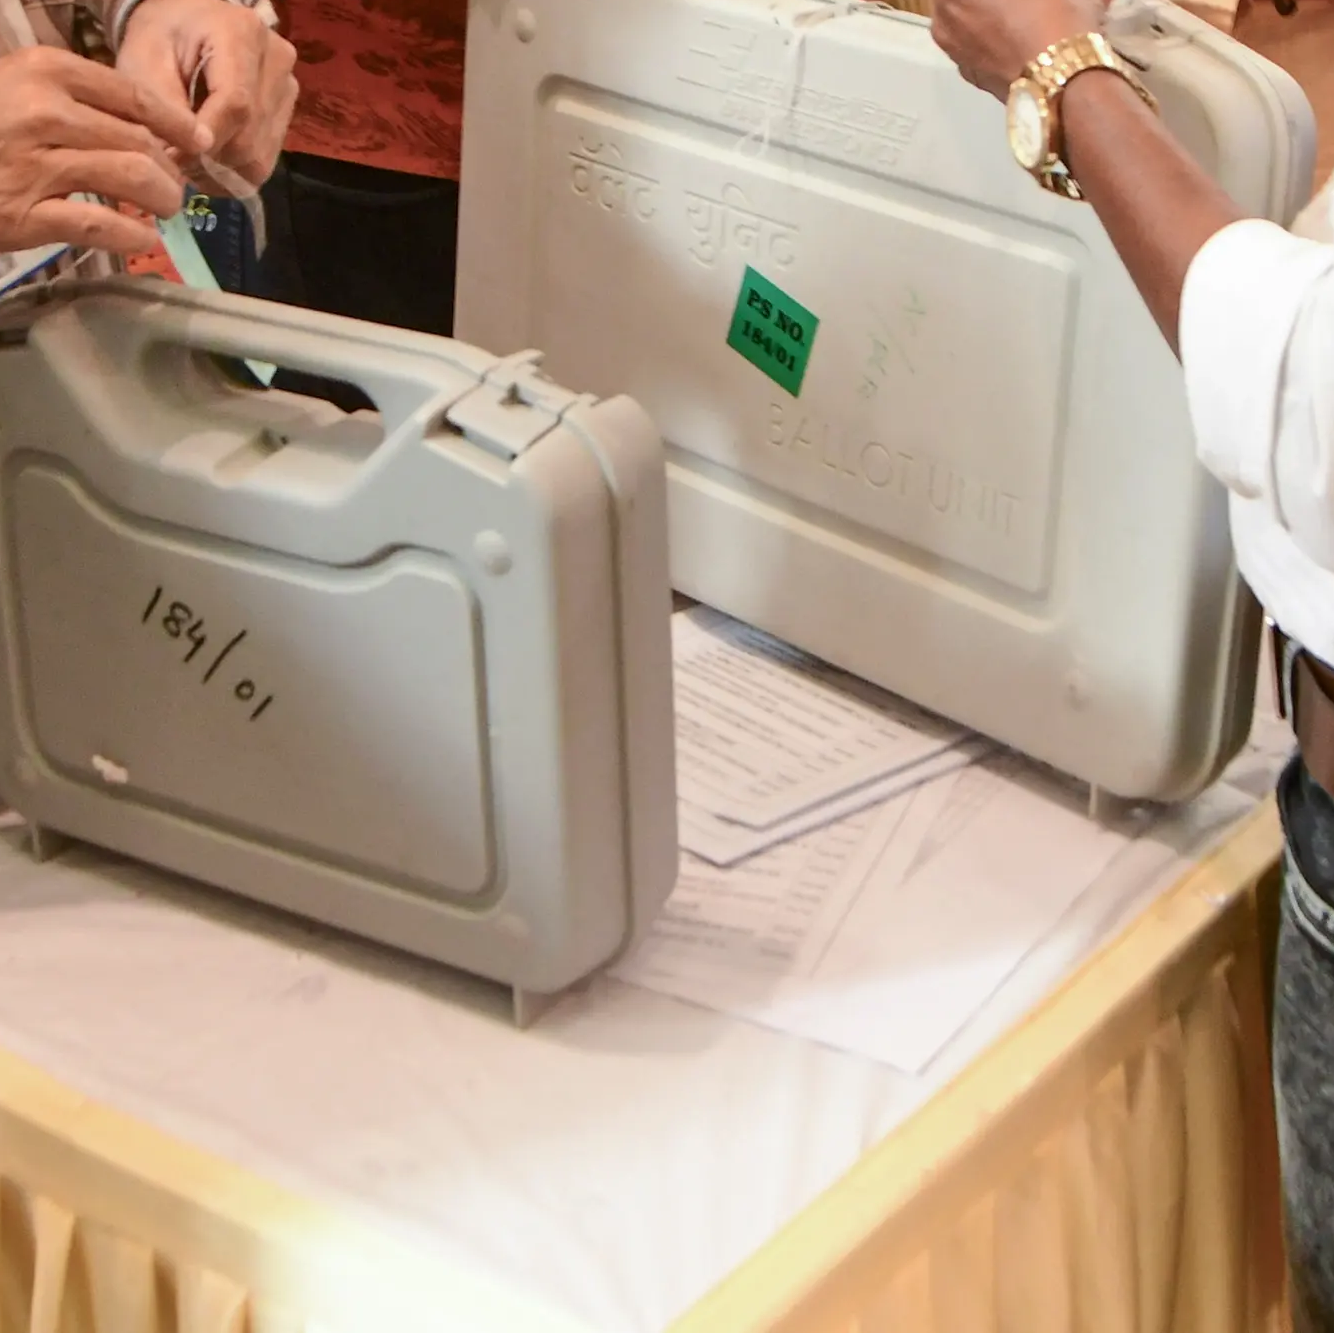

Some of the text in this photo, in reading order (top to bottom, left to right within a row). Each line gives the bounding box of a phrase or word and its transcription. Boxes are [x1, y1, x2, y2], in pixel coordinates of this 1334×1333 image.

[767, 402, 1020, 536] BALLOT UNIT
[142, 585, 274, 722] 184/01
